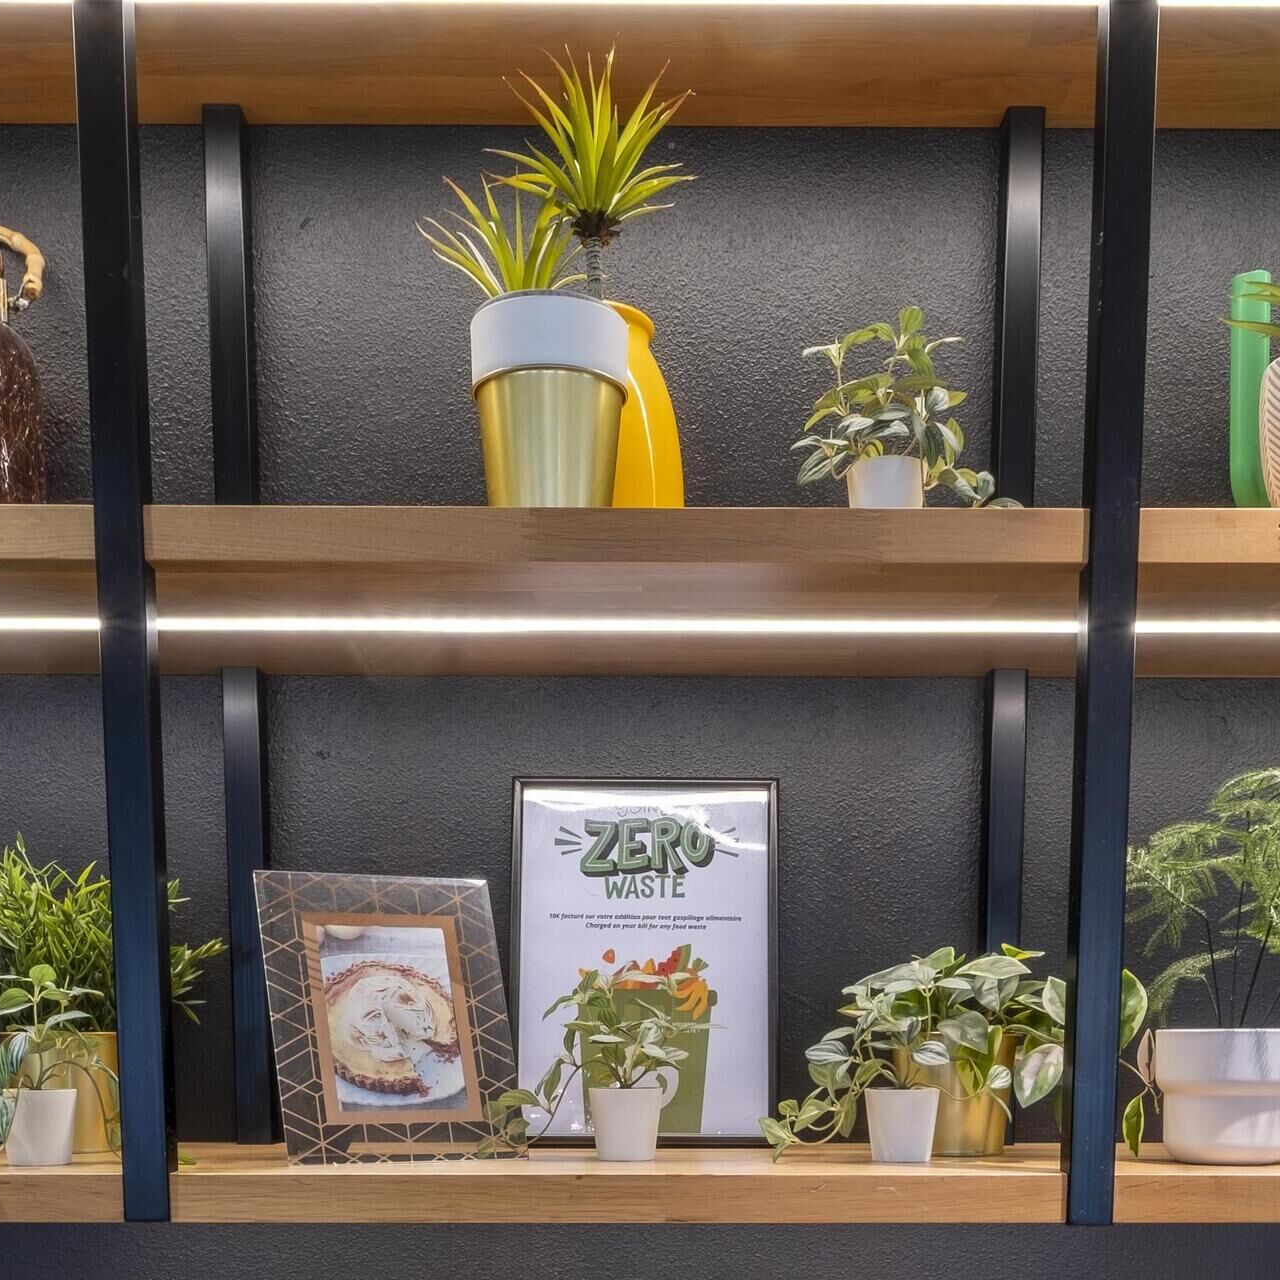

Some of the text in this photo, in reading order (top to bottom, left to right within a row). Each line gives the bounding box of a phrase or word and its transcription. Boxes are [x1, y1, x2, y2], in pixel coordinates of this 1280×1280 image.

[580, 817, 715, 877] ZERO
[605, 874, 686, 899] WASTE
[585, 922, 611, 930] Charged
[671, 923, 687, 931] food
